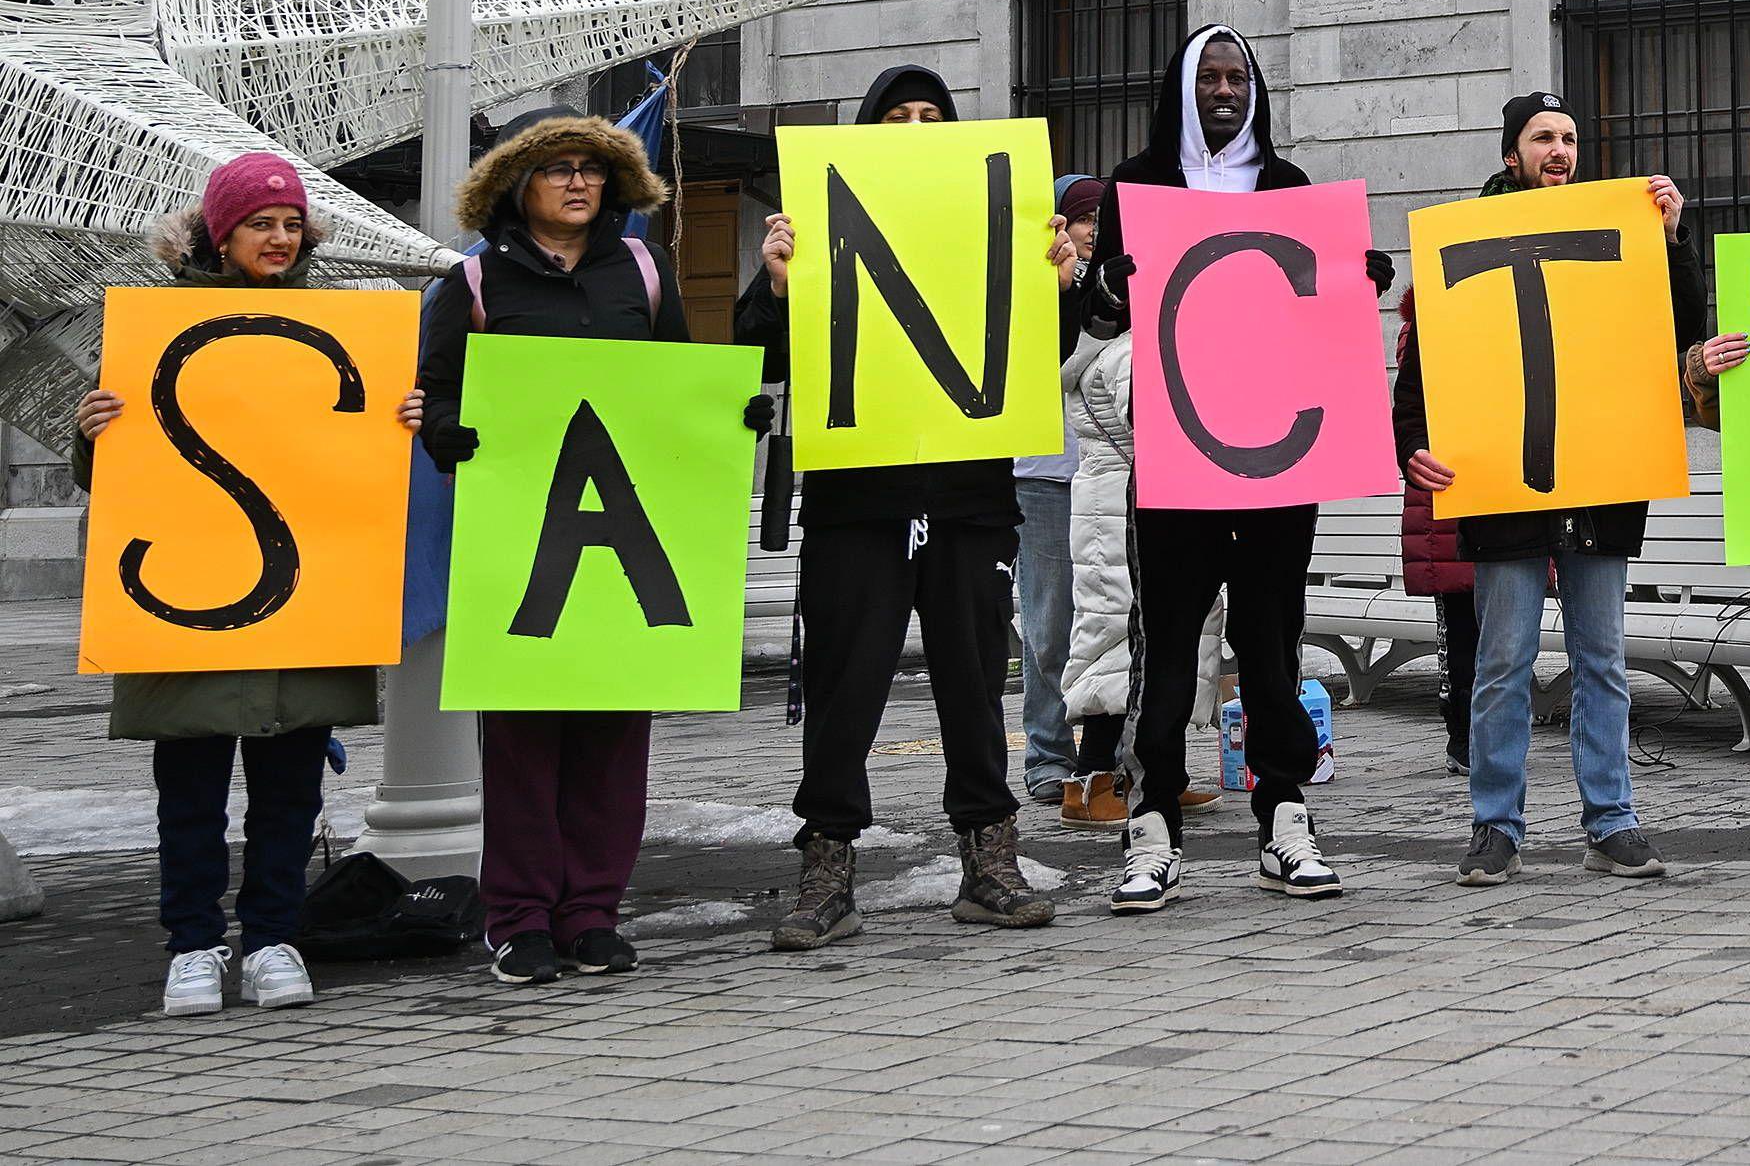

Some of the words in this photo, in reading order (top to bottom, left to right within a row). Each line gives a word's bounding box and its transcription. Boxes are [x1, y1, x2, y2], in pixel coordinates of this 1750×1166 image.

[827, 152, 1012, 429] N
[1159, 232, 1324, 479] C
[1440, 229, 1622, 494] T
[119, 314, 365, 631] S
[507, 399, 693, 638] A
